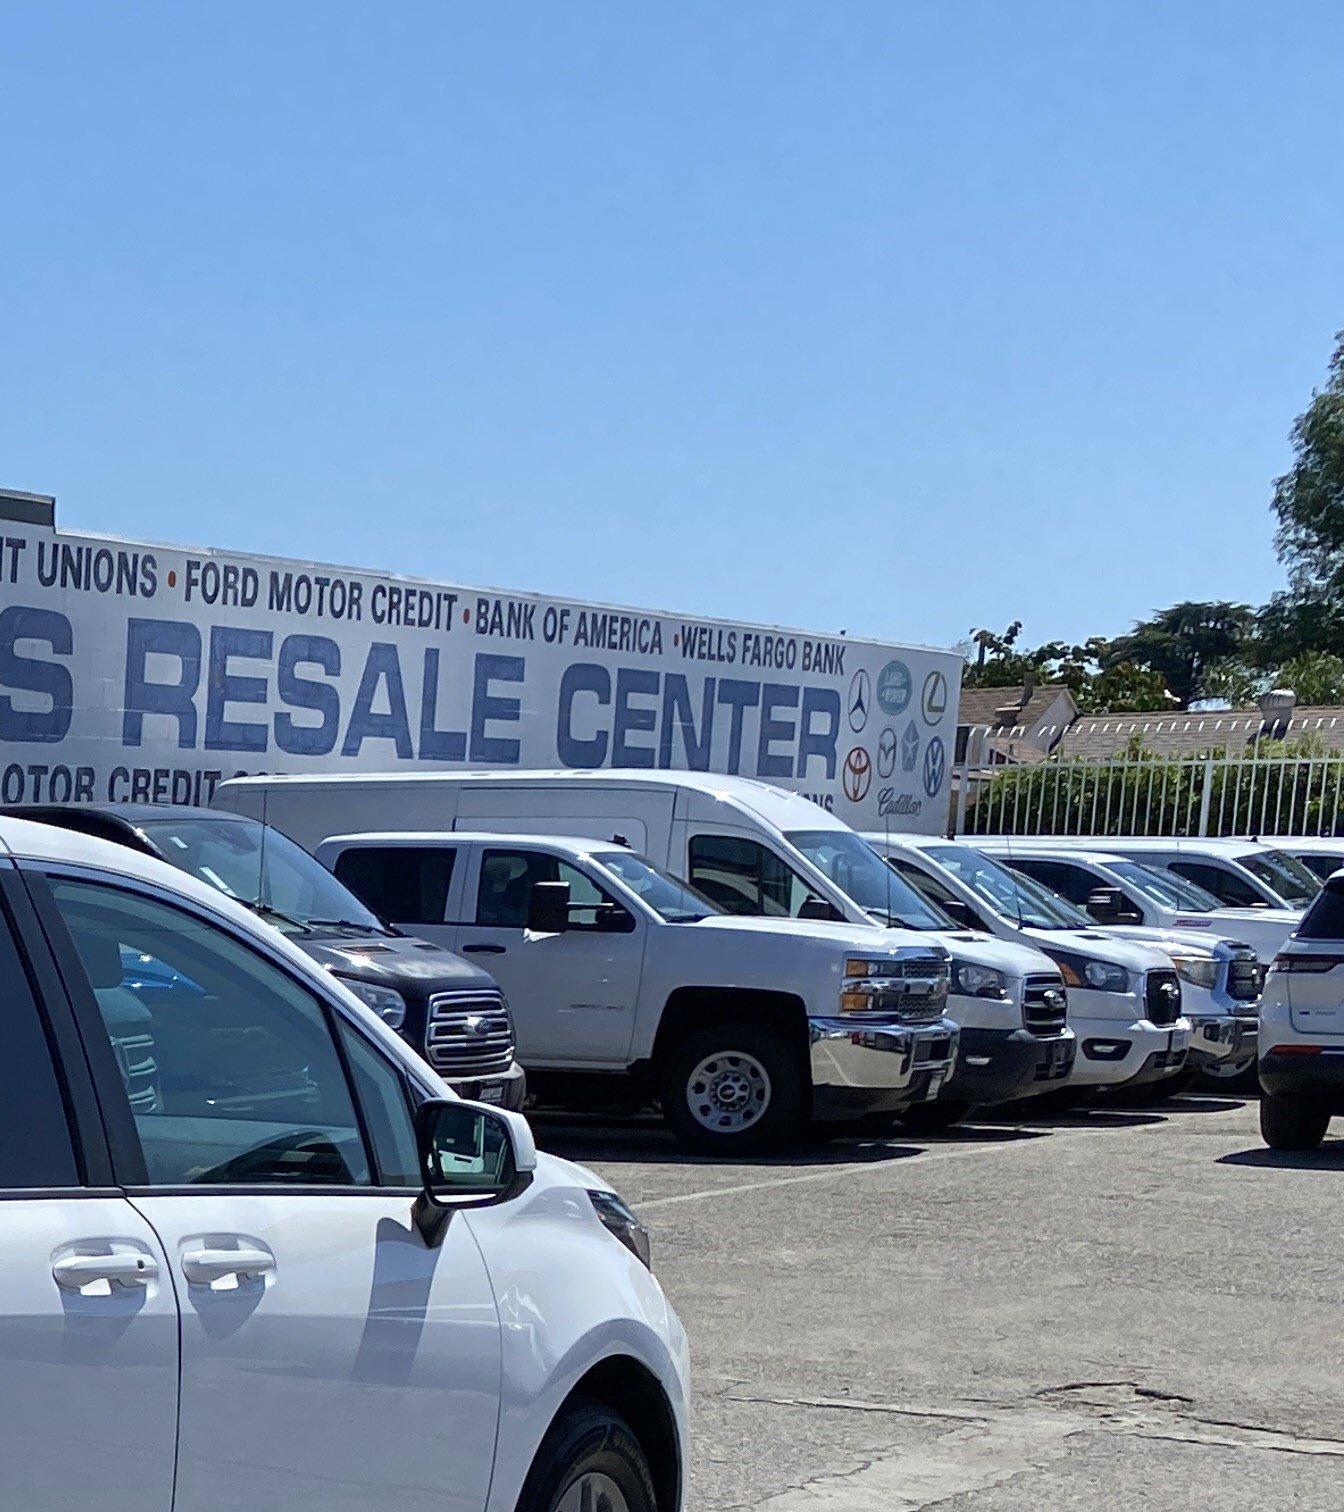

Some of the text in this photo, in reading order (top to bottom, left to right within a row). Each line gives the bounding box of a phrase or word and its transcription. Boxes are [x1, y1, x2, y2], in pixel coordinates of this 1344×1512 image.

[38, 541, 157, 598] UNIONS
[185, 560, 258, 607] FORD
[269, 571, 362, 620] MOTOR
[372, 585, 457, 631] CREDIT
[476, 598, 536, 640] BANK
[543, 607, 570, 643] OF
[574, 612, 662, 654] AMERICA
[681, 625, 736, 662] WELLS
[742, 634, 796, 669] FARGO
[802, 641, 845, 675] BANK
[124, 617, 525, 764] RESALE
[557, 663, 842, 780] CENTER
[109, 766, 221, 806] CREDIT
